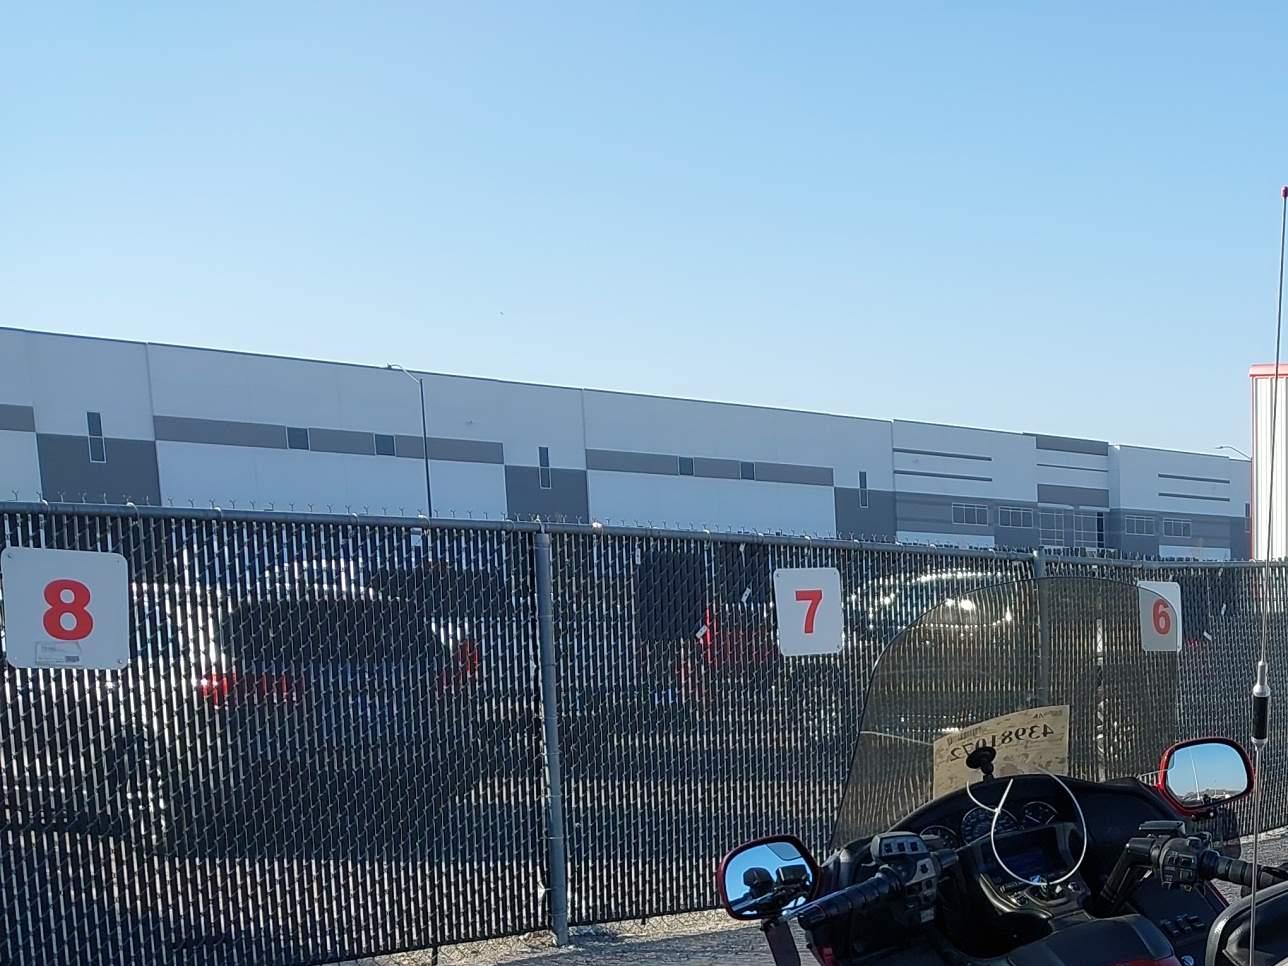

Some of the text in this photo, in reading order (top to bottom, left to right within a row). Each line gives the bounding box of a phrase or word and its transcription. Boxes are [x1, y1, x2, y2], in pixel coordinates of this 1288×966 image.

[43, 579, 94, 641] 8
[795, 590, 823, 634] 7
[1152, 598, 1171, 635] 6
